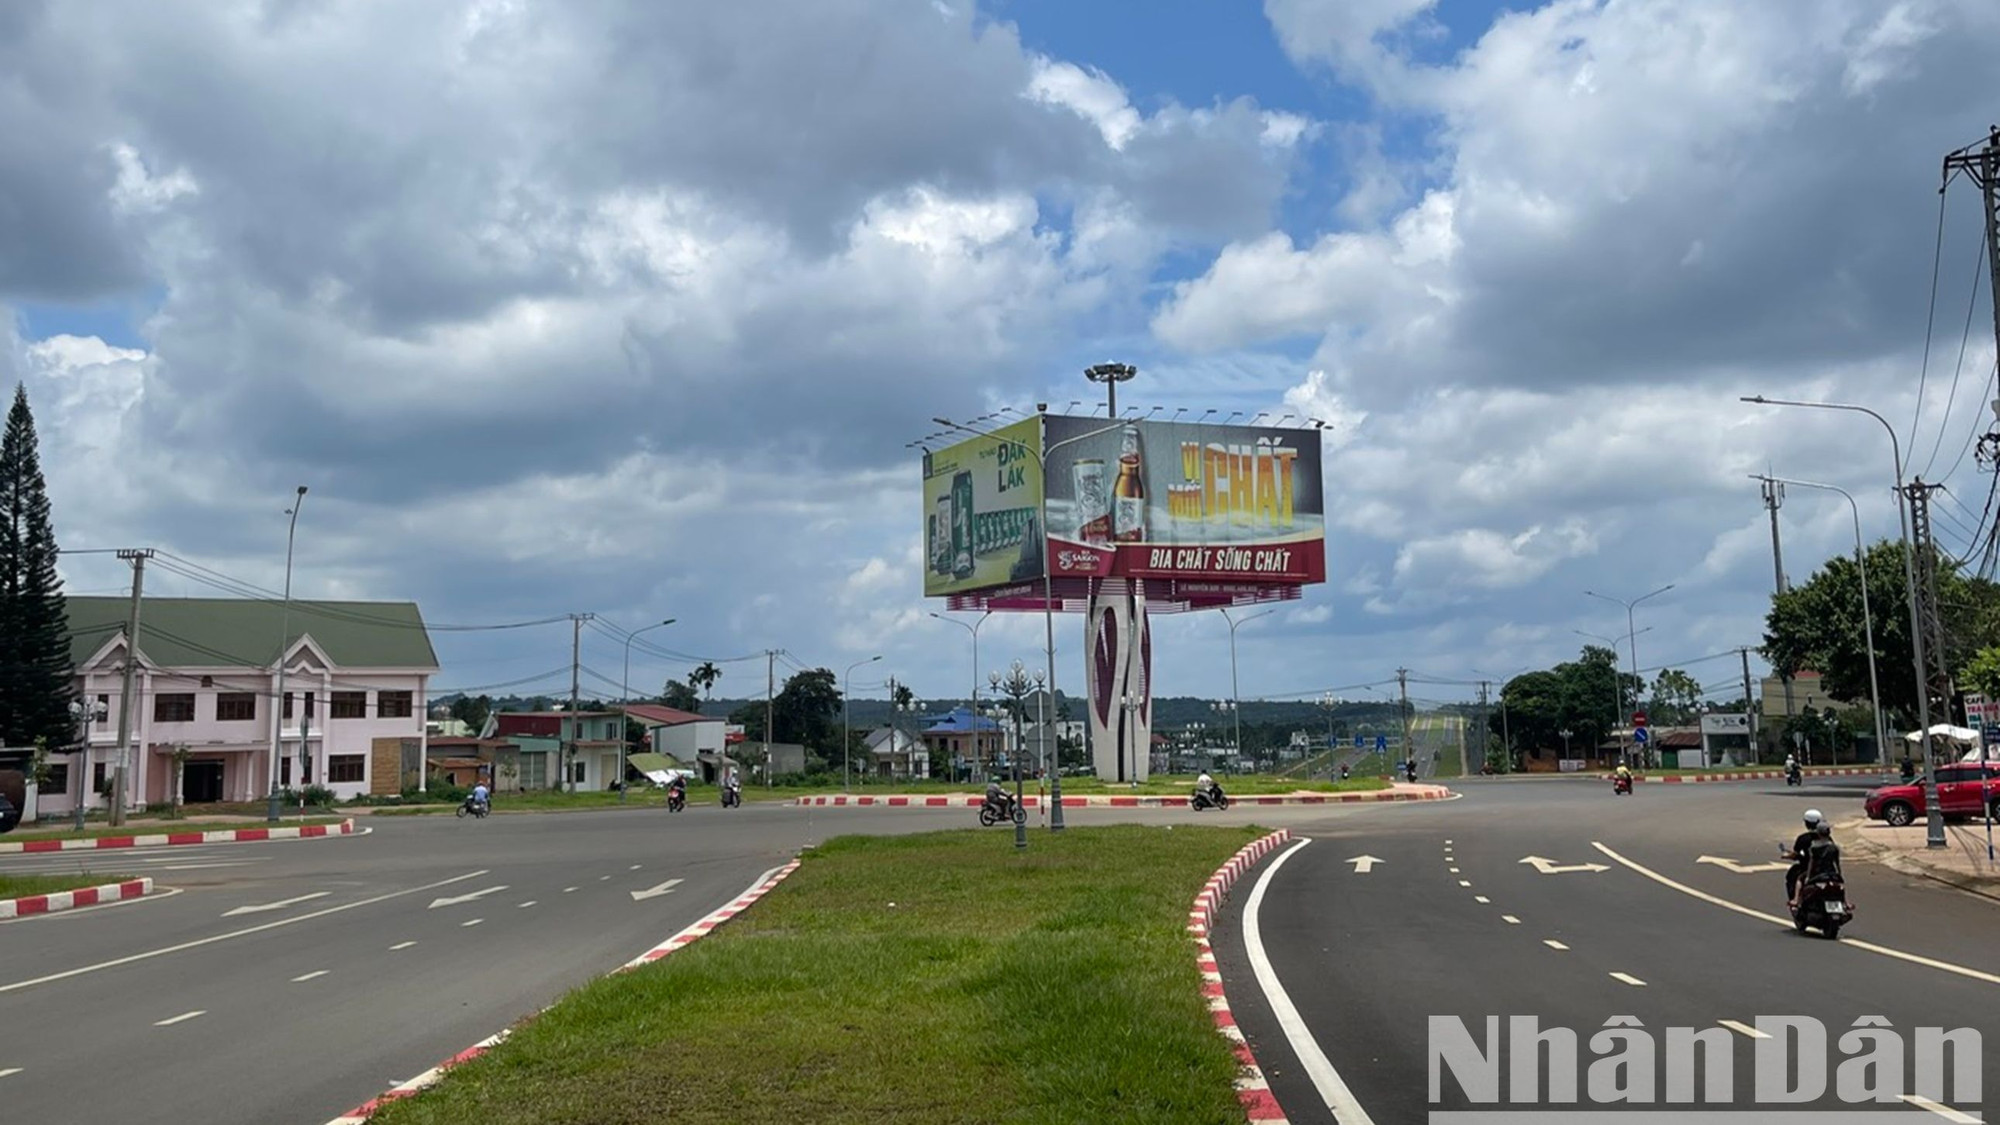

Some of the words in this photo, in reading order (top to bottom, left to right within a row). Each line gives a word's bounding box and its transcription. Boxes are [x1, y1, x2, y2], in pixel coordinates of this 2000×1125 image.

[1203, 436, 1298, 529] CHẤT
[1150, 548, 1172, 569] BIA
[1176, 546, 1211, 570] CHẤT
[1255, 547, 1291, 572] CHẤT
